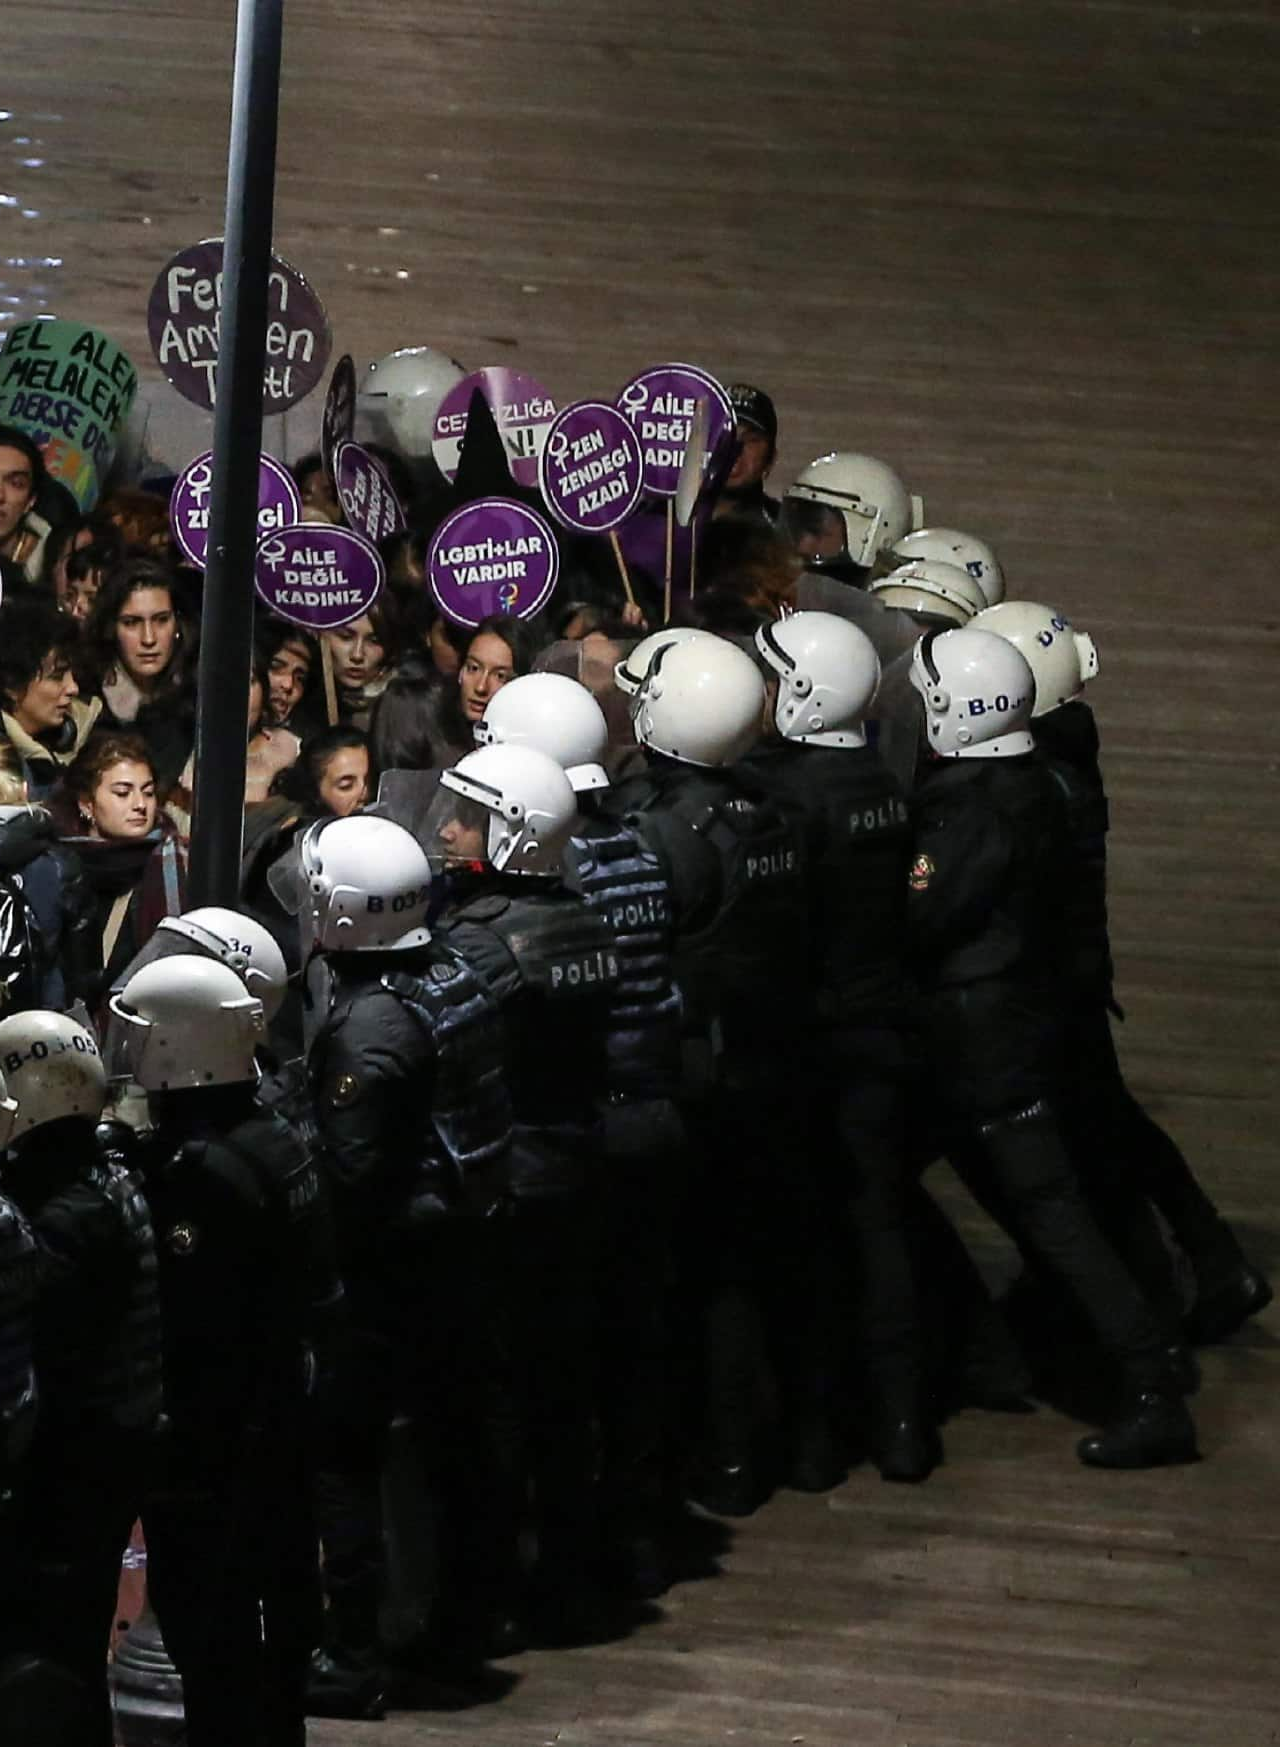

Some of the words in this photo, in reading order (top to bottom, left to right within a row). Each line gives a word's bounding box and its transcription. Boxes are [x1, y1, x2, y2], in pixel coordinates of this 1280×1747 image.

[6, 323, 51, 353] EL
[651, 392, 695, 416] AİLE
[642, 419, 692, 442] DEĞİ
[569, 429, 606, 462] ZEN
[558, 440, 633, 497] ZENDEGİ
[291, 547, 336, 566] AİLE
[438, 536, 542, 567] LGBTİ+LAR
[284, 568, 349, 586] DEĞİL
[453, 560, 527, 586] VARDIR
[275, 589, 363, 606] KADINIZ
